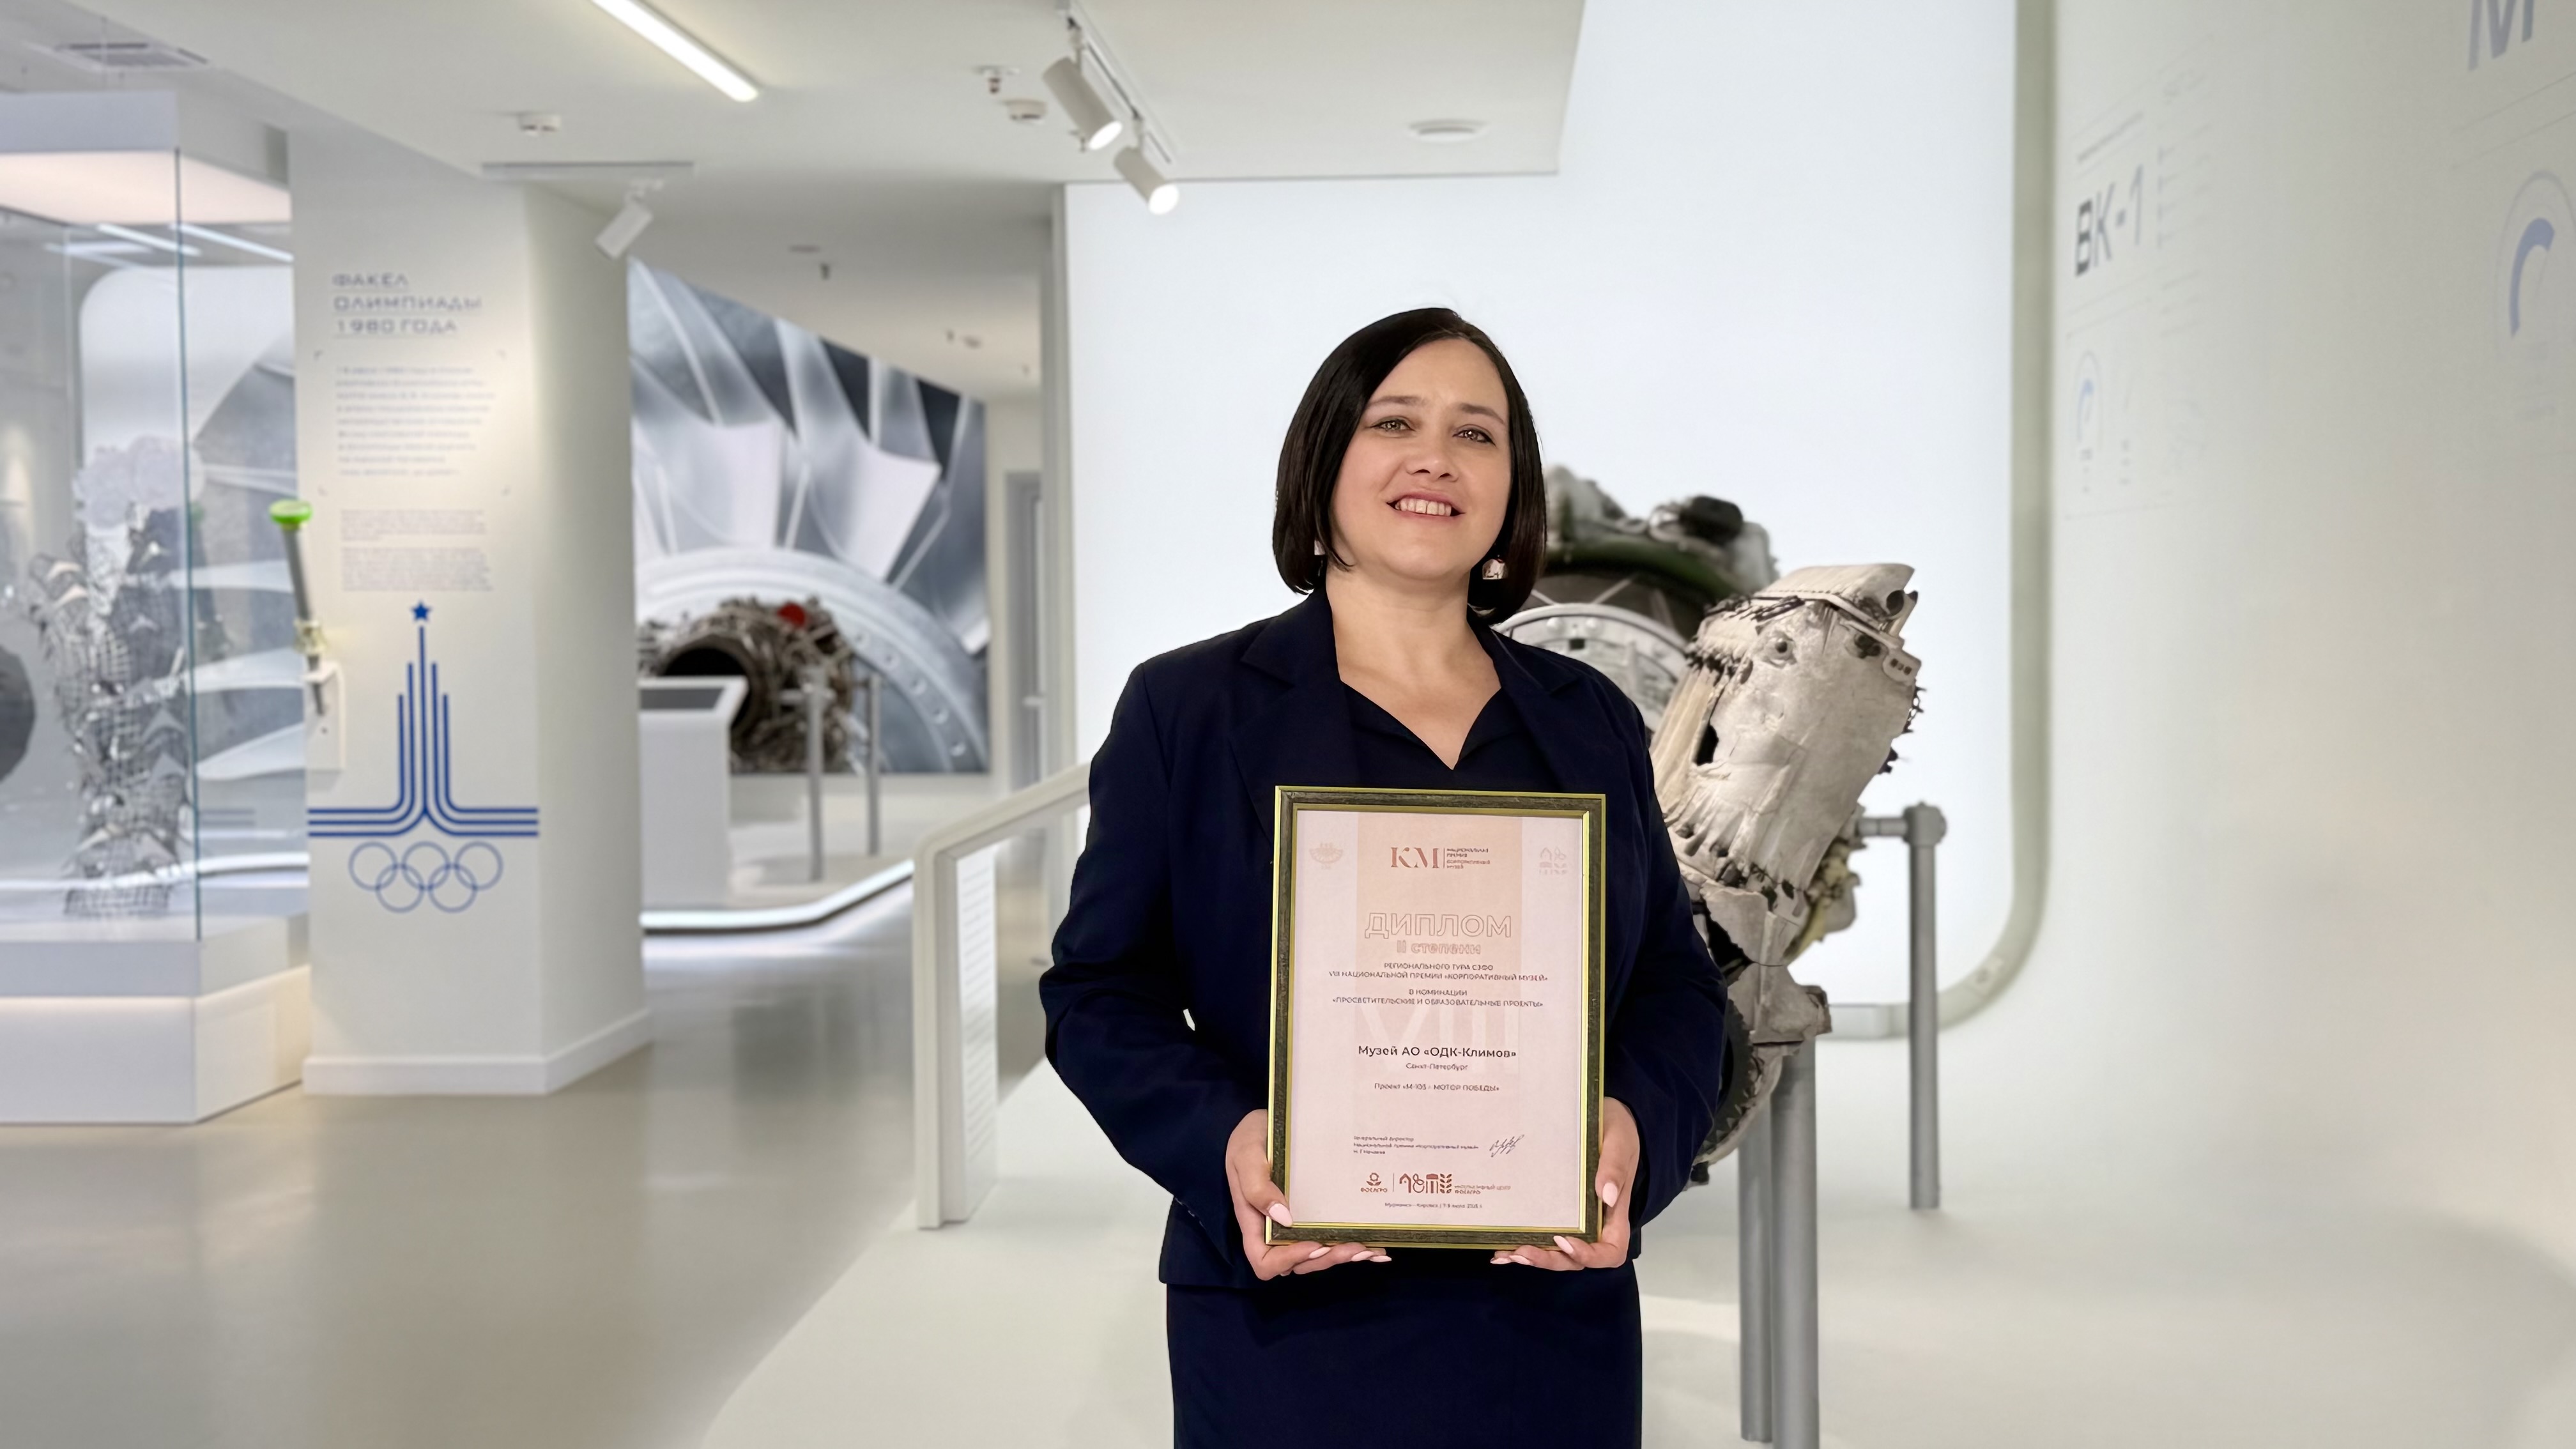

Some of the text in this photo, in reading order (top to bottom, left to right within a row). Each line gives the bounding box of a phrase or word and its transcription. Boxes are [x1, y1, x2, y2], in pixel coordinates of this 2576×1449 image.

[332, 273, 410, 287] ФАКЕЛ
[334, 295, 482, 311] ОЛИМПИАДЫ
[337, 319, 457, 334] 1980 ГОДА
[1365, 912, 1512, 939] ДИПЛОМ
[1358, 1045, 1516, 1058] Музей АО «ОДК-Климов»
[1406, 1062, 1468, 1071] Санкт-Петербург
